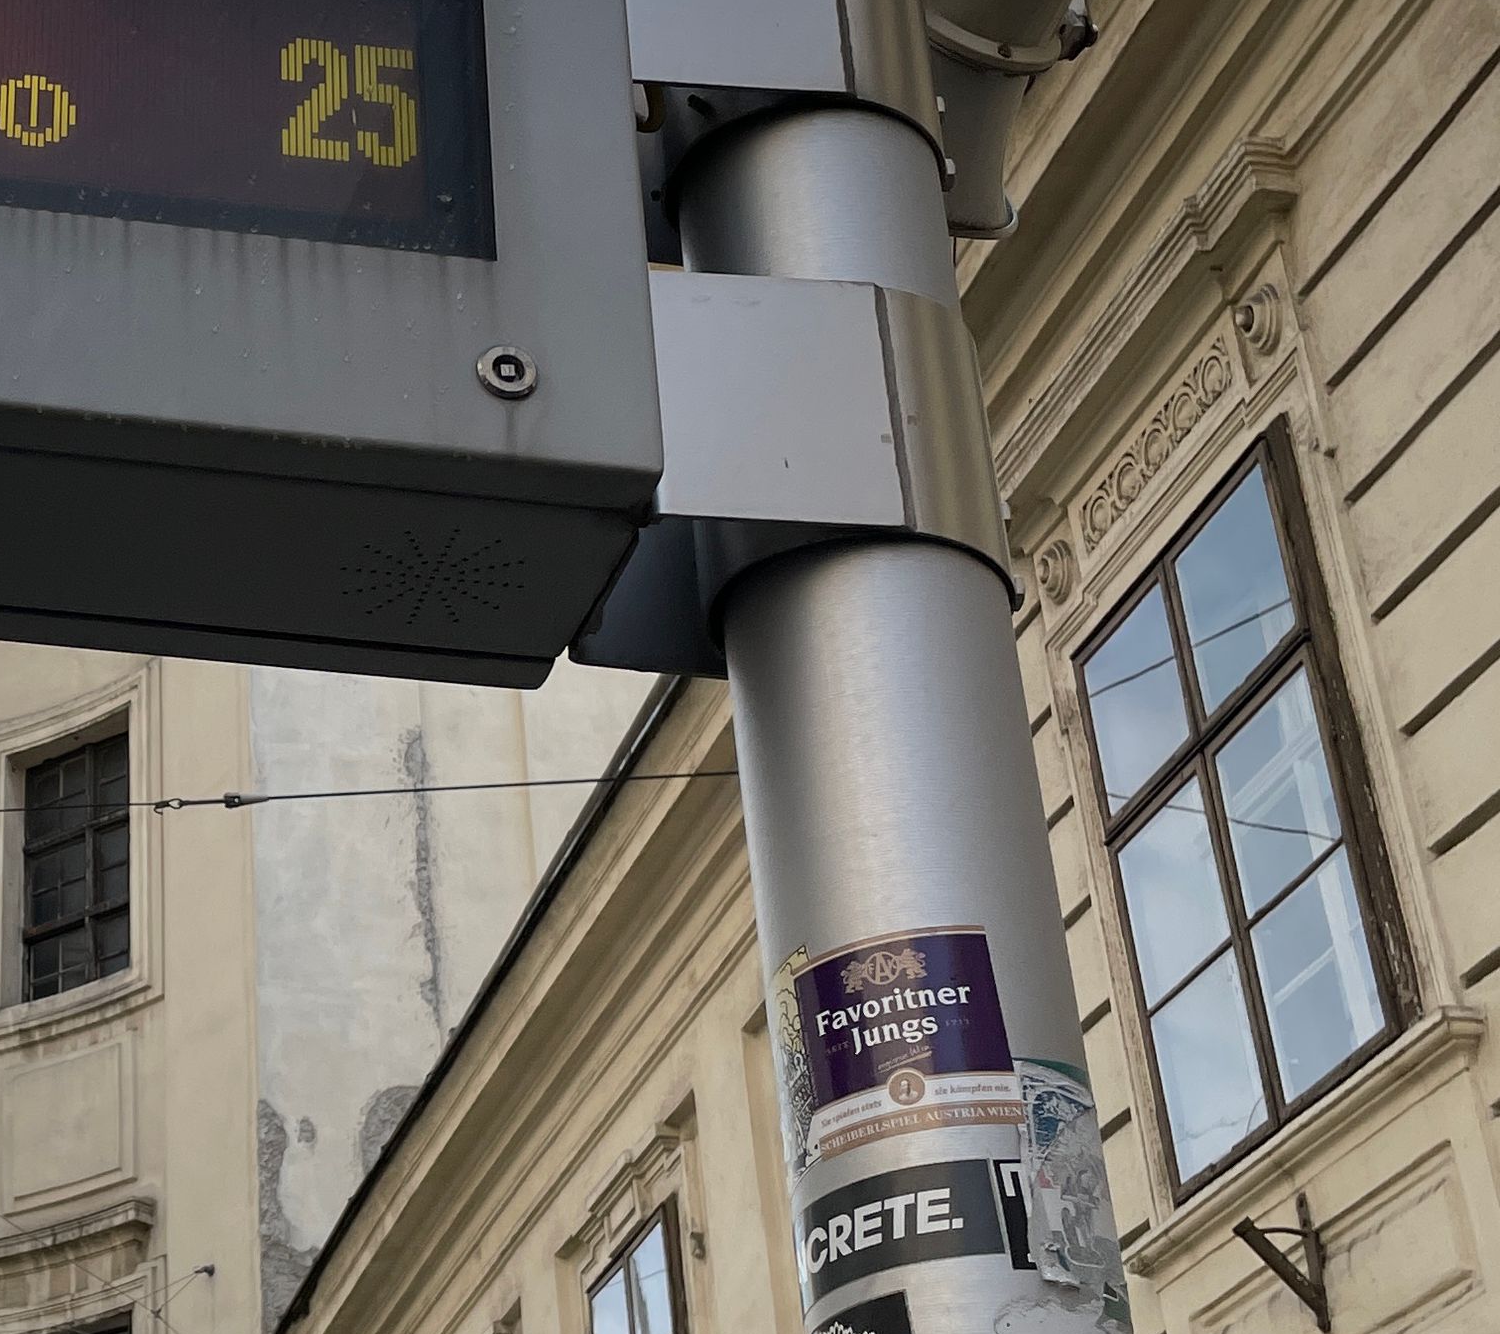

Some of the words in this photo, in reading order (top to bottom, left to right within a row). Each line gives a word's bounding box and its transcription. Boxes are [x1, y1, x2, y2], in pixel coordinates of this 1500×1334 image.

[281, 37, 418, 167] 25
[815, 985, 971, 1038] Favoritner
[850, 1016, 939, 1055] Jungs
[820, 1114, 923, 1152] SCHEIBERLSPIEL
[925, 1106, 986, 1122] AUSTRIA
[987, 1105, 1023, 1117] WIEN
[806, 1187, 964, 1274] CRETE.
